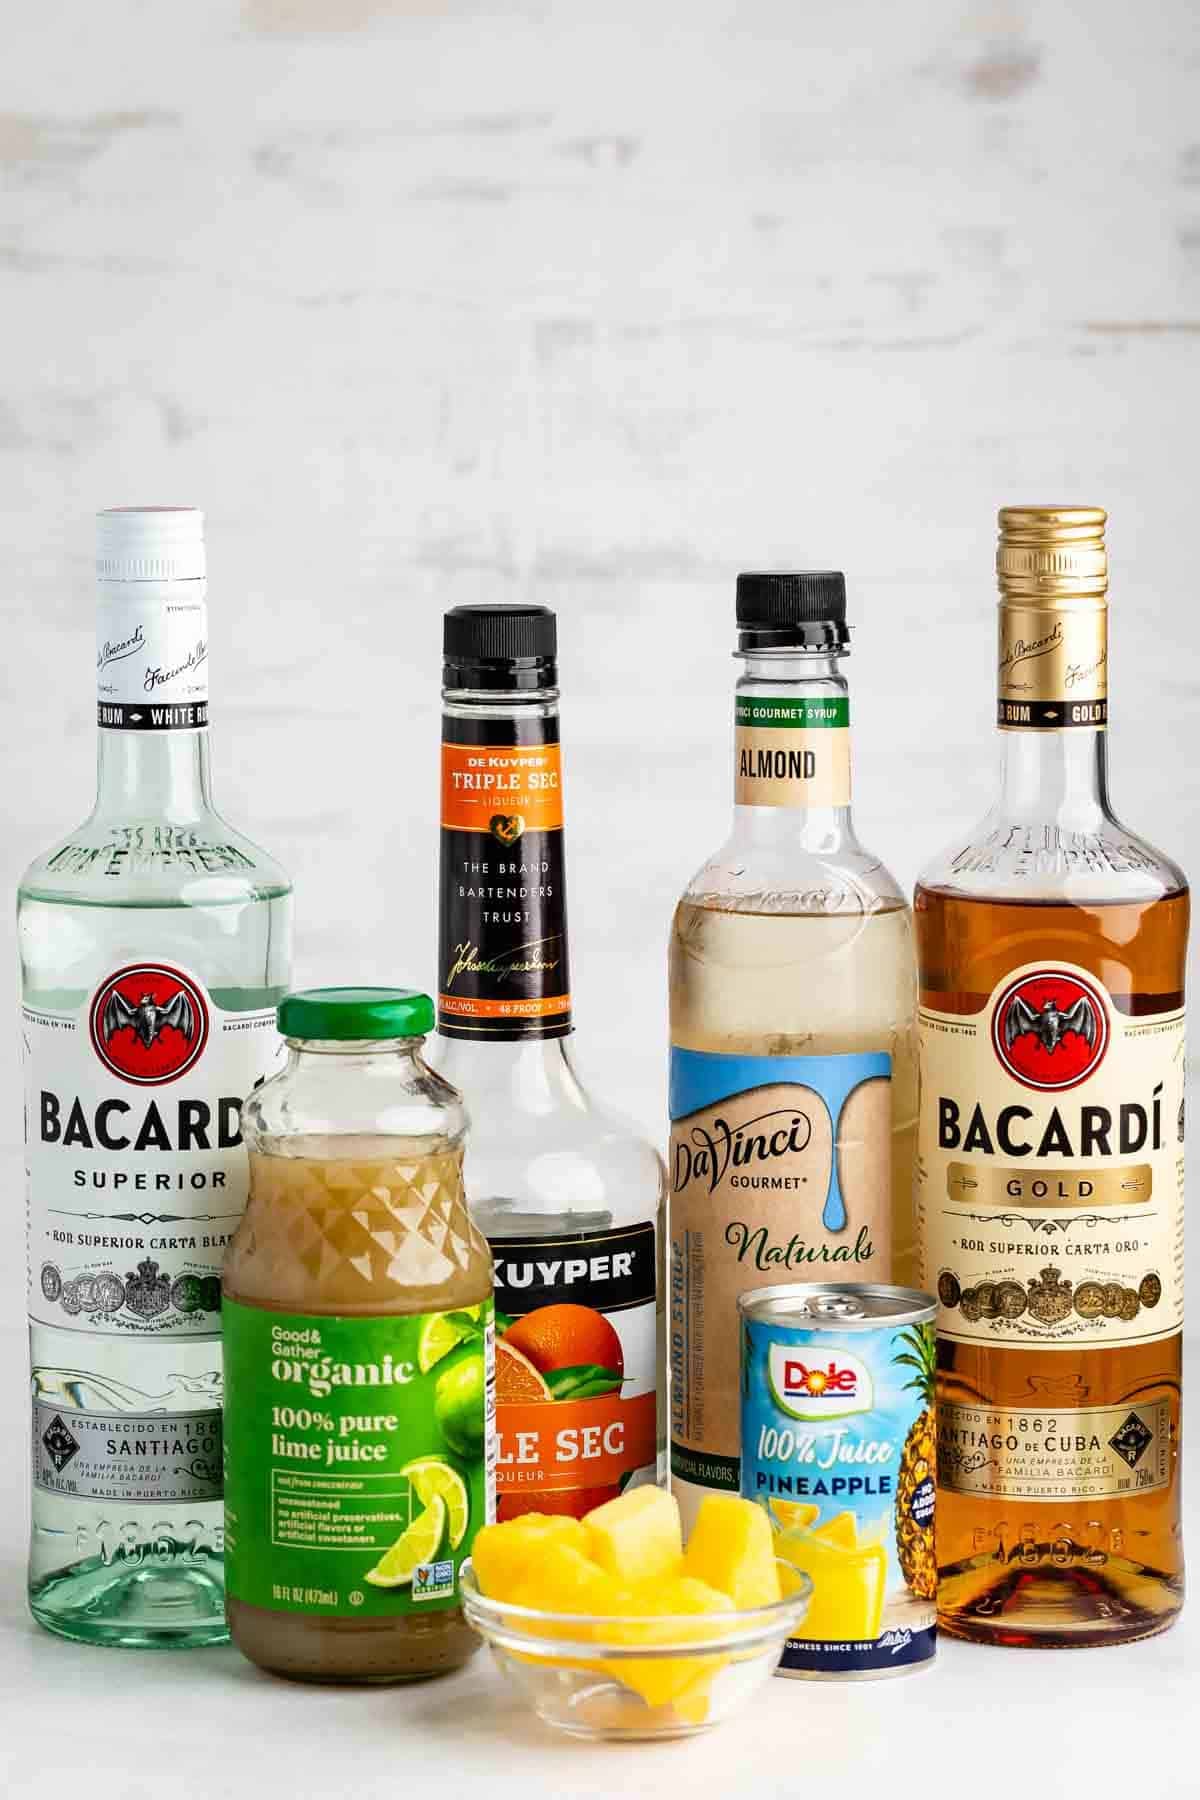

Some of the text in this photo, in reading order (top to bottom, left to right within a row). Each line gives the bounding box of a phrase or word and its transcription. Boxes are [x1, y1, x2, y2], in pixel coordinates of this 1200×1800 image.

[151, 706, 194, 725] WHITE
[753, 708, 803, 719] GOURMET
[807, 708, 837, 719] SYRUP
[1008, 704, 1030, 721] RUM
[1072, 704, 1101, 722] GOLD
[740, 749, 816, 779] ALMOND
[452, 771, 558, 790] TRIPLE SEC
[464, 862, 549, 874] THE BRAND
[459, 886, 553, 898] BARTENDERS
[483, 911, 531, 923] TRUST
[513, 1002, 541, 1014] PROOF
[40, 1077, 264, 1151] BACARD
[938, 1081, 1163, 1157] BACARDÍ
[674, 1109, 811, 1193] DaVinci
[74, 1169, 225, 1190] SUPERIOR
[731, 1176, 800, 1189] GOURMET
[1007, 1179, 1093, 1198] GOLD
[78, 1233, 144, 1249] SUPERIOR
[150, 1235, 196, 1249] CARTA
[725, 1222, 874, 1271] Naturals
[990, 1241, 1060, 1256] SUPERIOR
[1065, 1242, 1110, 1256] CARTA
[1115, 1239, 1139, 1253] ORO
[272, 1342, 321, 1359] Gather
[272, 1354, 415, 1398] organic
[784, 1361, 856, 1393] Dole
[72, 1419, 155, 1433] ESTABLECIDO
[162, 1423, 176, 1433] EN
[272, 1407, 399, 1437] 100% pure
[986, 1416, 1001, 1425] EN
[1008, 1417, 1057, 1433] 1862
[107, 1438, 216, 1456] SANTIAGO
[556, 1422, 624, 1461] SEC
[758, 1424, 816, 1463] 100%
[817, 1428, 895, 1470] Juice
[1025, 1442, 1039, 1452] DE
[1044, 1435, 1101, 1452] CUBA
[272, 1434, 388, 1467] lime juice
[93, 1462, 135, 1472] EMPRESA
[1030, 1457, 1075, 1466] EMPRESA
[1079, 1457, 1091, 1465] DE
[998, 1466, 1049, 1477] FAMILIA
[92, 1487, 117, 1496] MADE
[135, 1489, 176, 1497] PUERTO
[181, 1487, 206, 1496] RICO
[757, 1472, 891, 1496] PINEAPPLE
[1026, 1486, 1067, 1494] PUERTO
[278, 1497, 340, 1510] unsweetened
[291, 1509, 331, 1521] artificial
[278, 1519, 365, 1533] artificial flavors or
[278, 1530, 375, 1544] artificial sweeteners
[824, 1643, 851, 1652] SINCE
